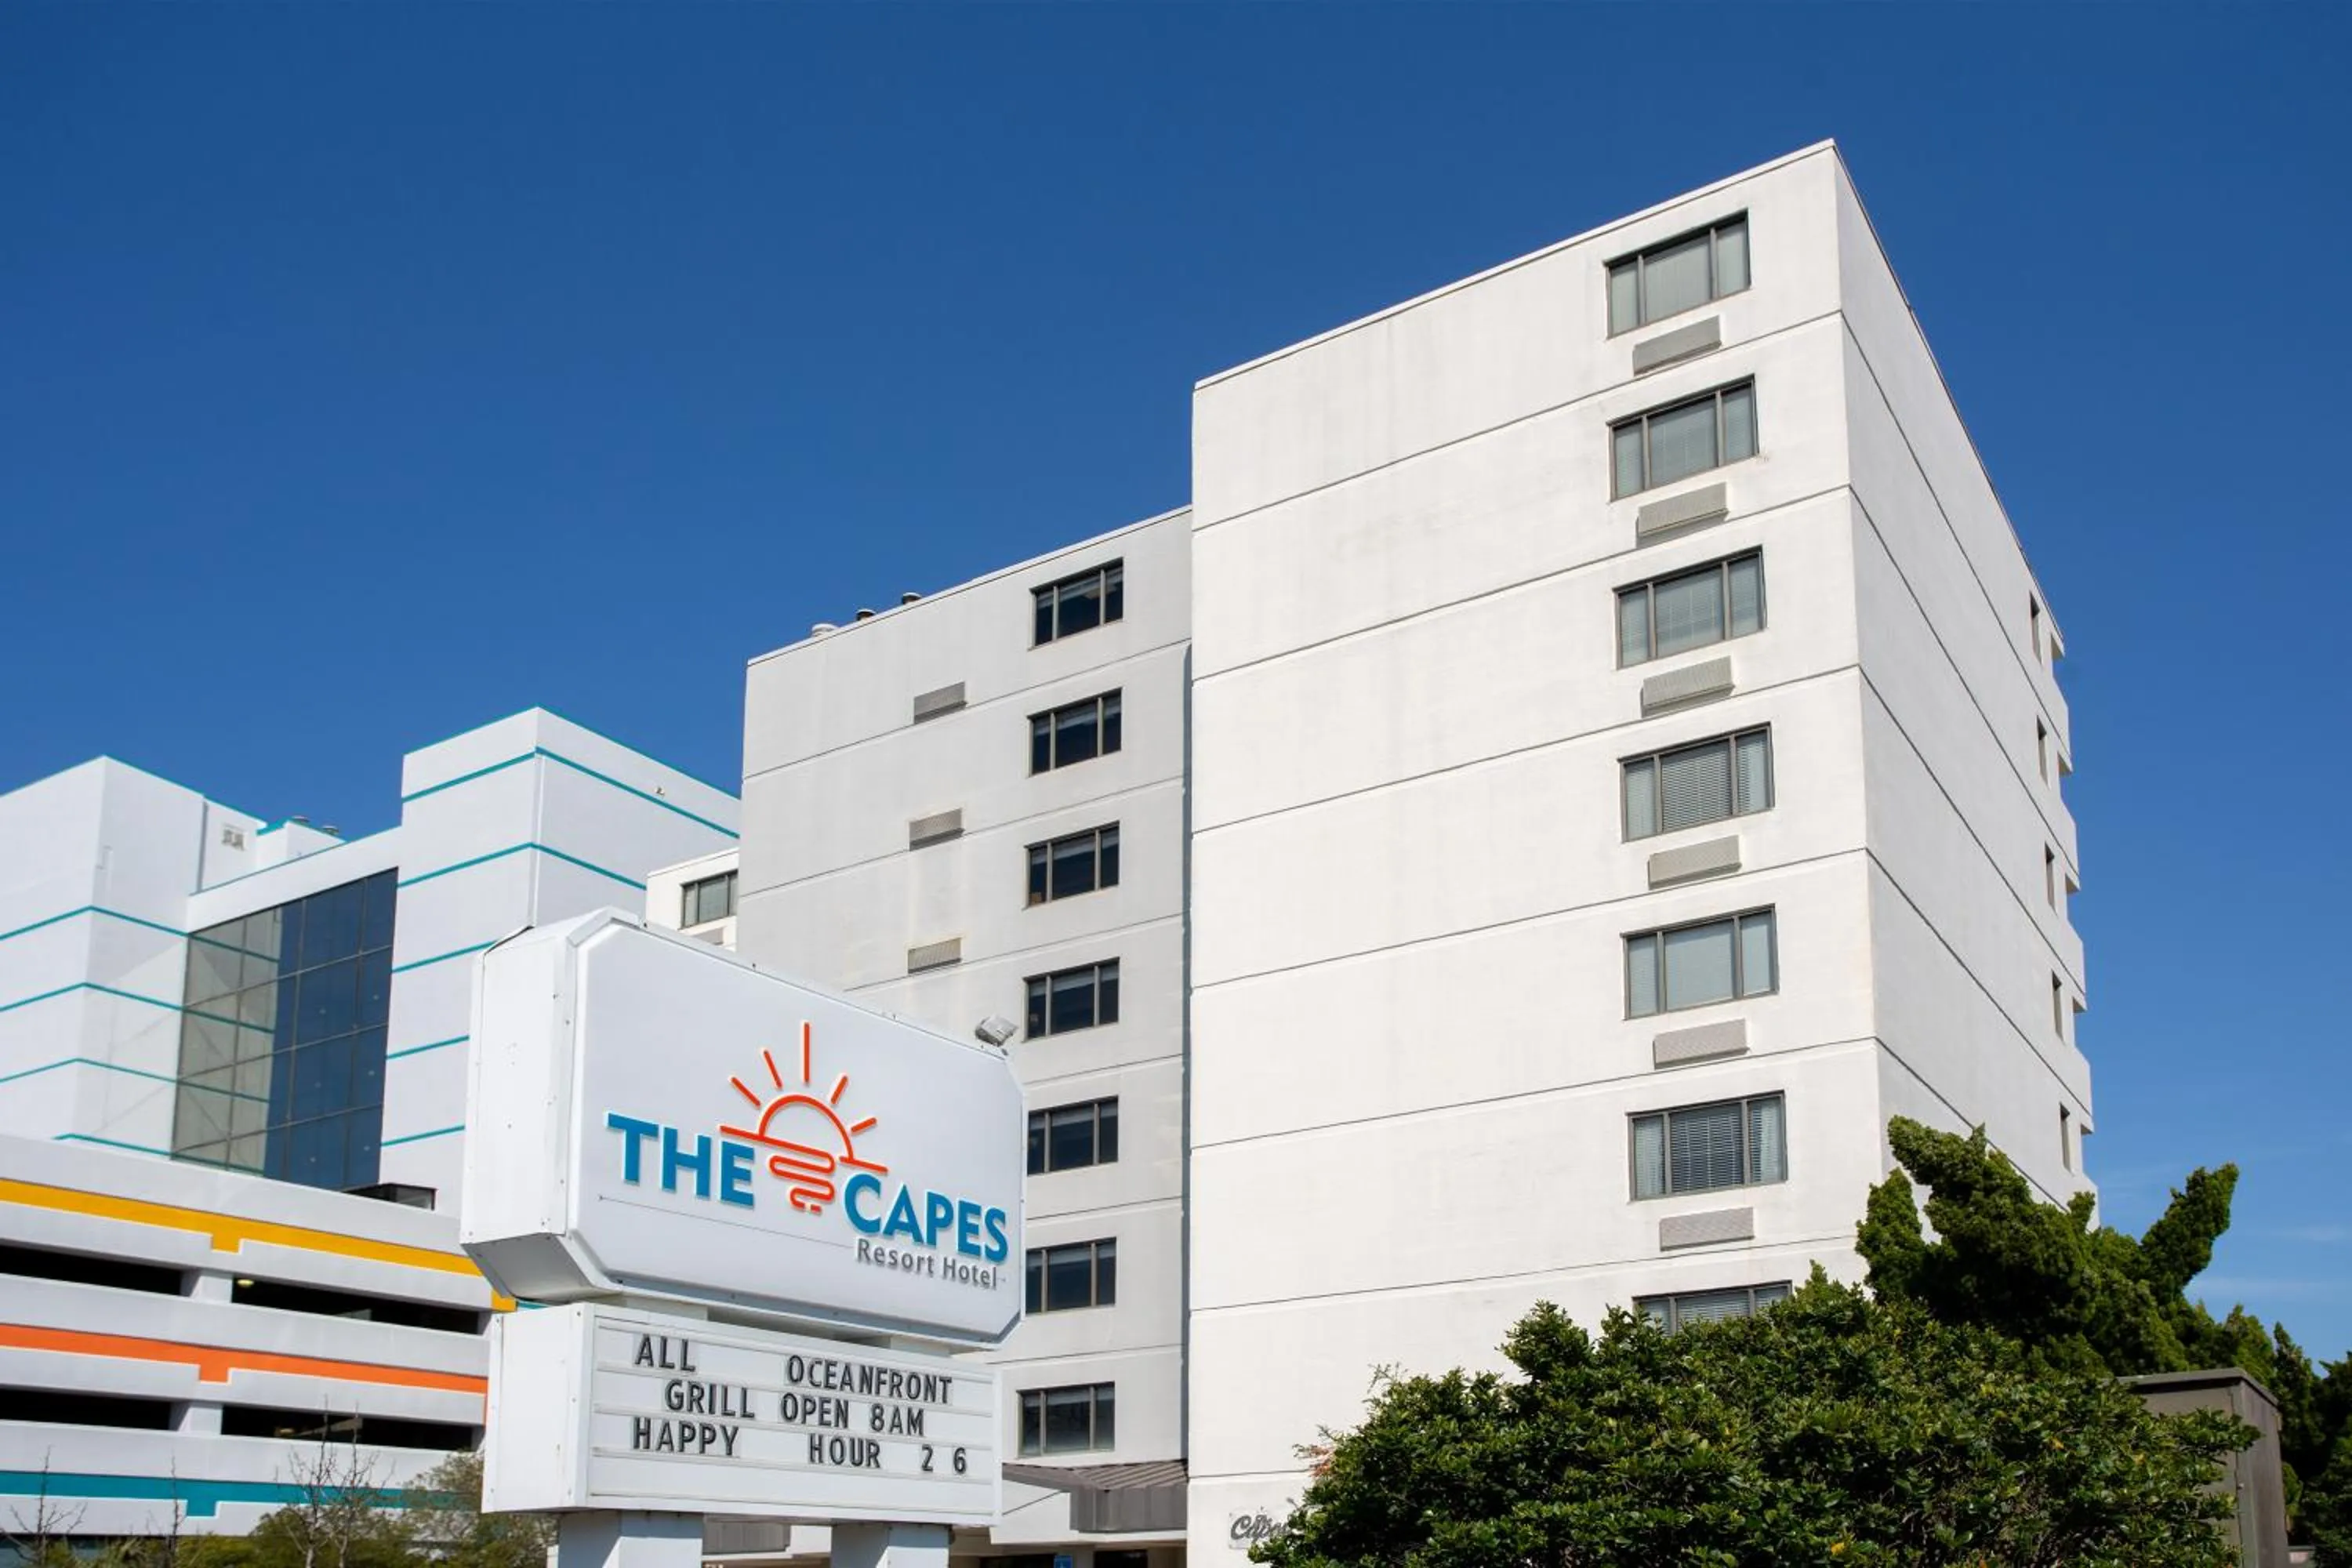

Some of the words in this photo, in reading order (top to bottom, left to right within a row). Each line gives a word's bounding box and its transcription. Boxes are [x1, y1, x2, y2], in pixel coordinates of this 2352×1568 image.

[607, 1112, 754, 1206] THE
[845, 1174, 1007, 1261] CAPES
[857, 1238, 936, 1275] Resort
[942, 1258, 996, 1287] Hotel
[635, 1334, 695, 1372] ALL
[787, 1355, 952, 1404] OCEANFRONT
[667, 1380, 754, 1418] GRILL
[782, 1392, 848, 1428] OPEN
[871, 1404, 923, 1436] 8AM
[633, 1414, 739, 1456] HAPPY
[811, 1434, 880, 1468] HOUR
